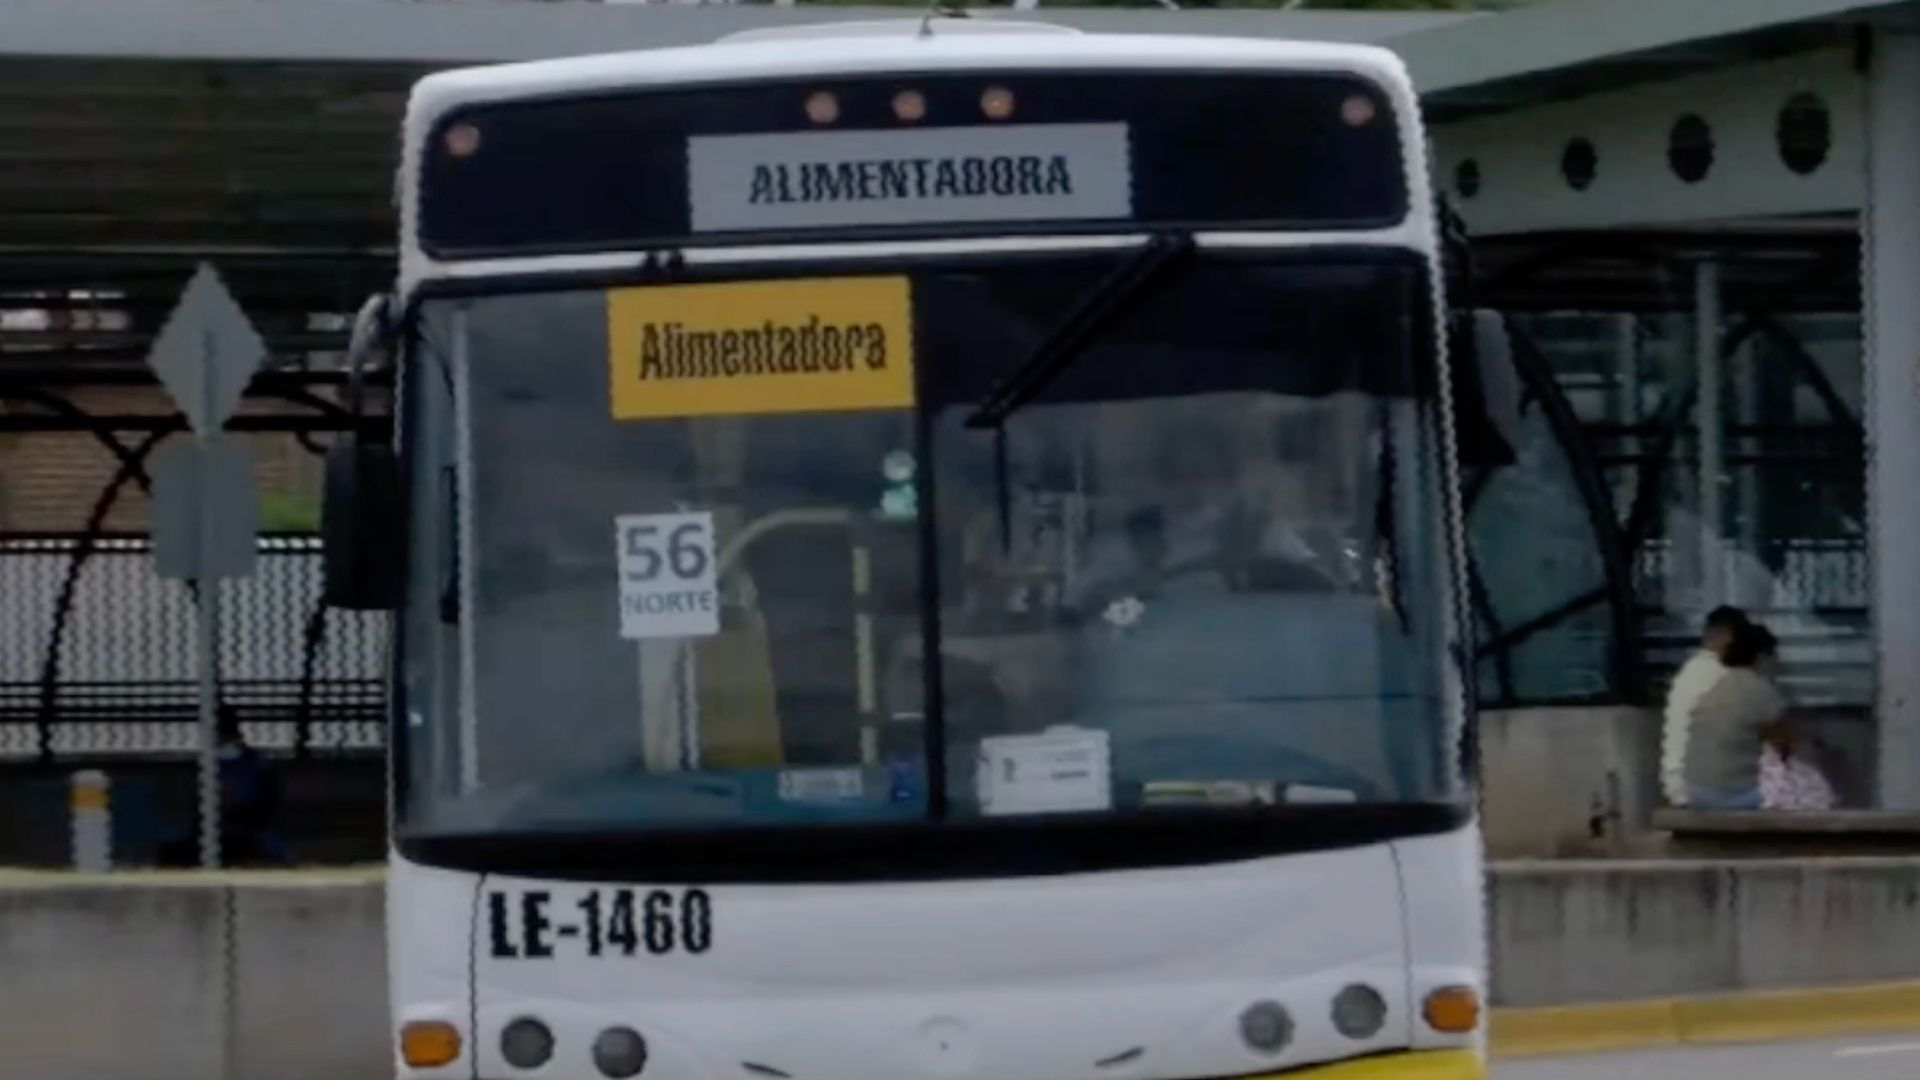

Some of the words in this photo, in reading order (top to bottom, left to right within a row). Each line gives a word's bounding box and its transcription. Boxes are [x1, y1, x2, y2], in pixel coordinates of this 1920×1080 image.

[749, 155, 1073, 204] ALIMENTADORA
[640, 315, 886, 380] Alimentadora
[626, 523, 708, 581] 56
[624, 591, 713, 615] NORTE
[490, 889, 711, 958] LE-1460
